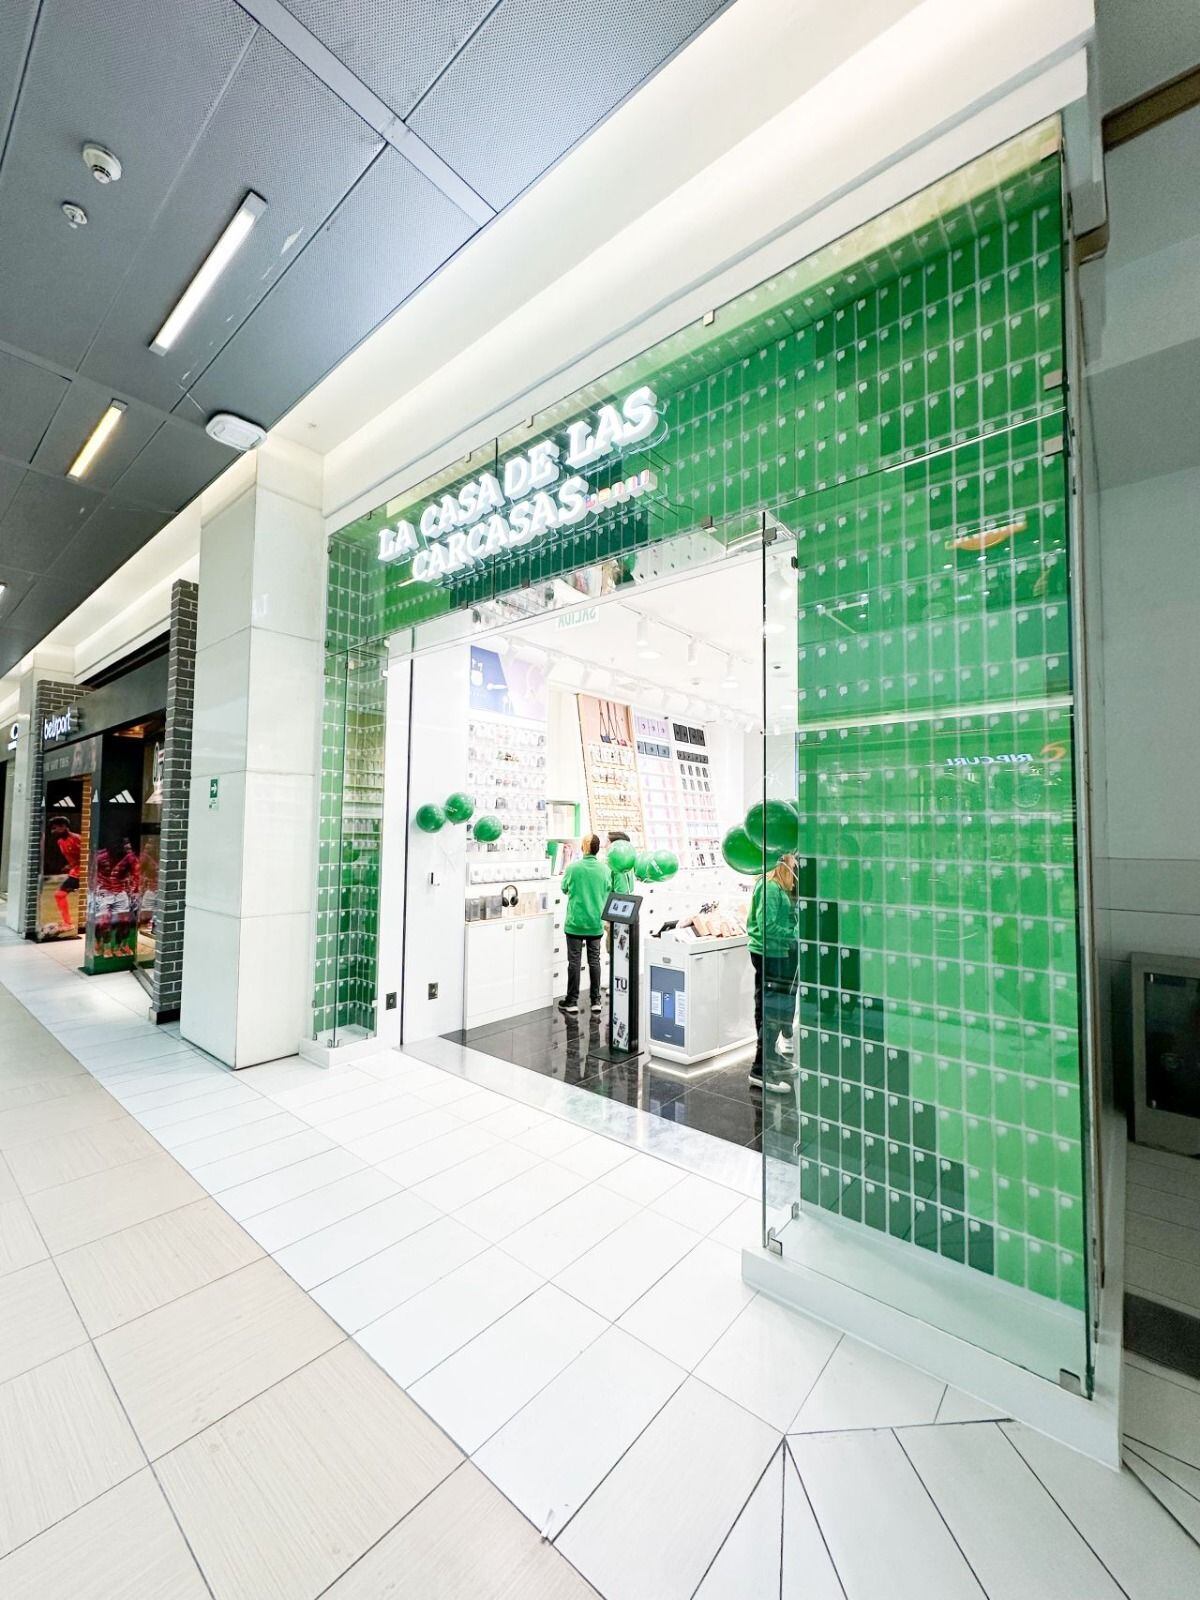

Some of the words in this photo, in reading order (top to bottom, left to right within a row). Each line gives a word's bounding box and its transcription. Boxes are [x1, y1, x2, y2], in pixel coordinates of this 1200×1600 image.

[378, 520, 419, 562] LA
[420, 473, 505, 539] CASA
[504, 440, 560, 500] DE
[566, 386, 659, 469] LAS
[412, 475, 590, 582] CARCASAS
[615, 977, 628, 990] TU
